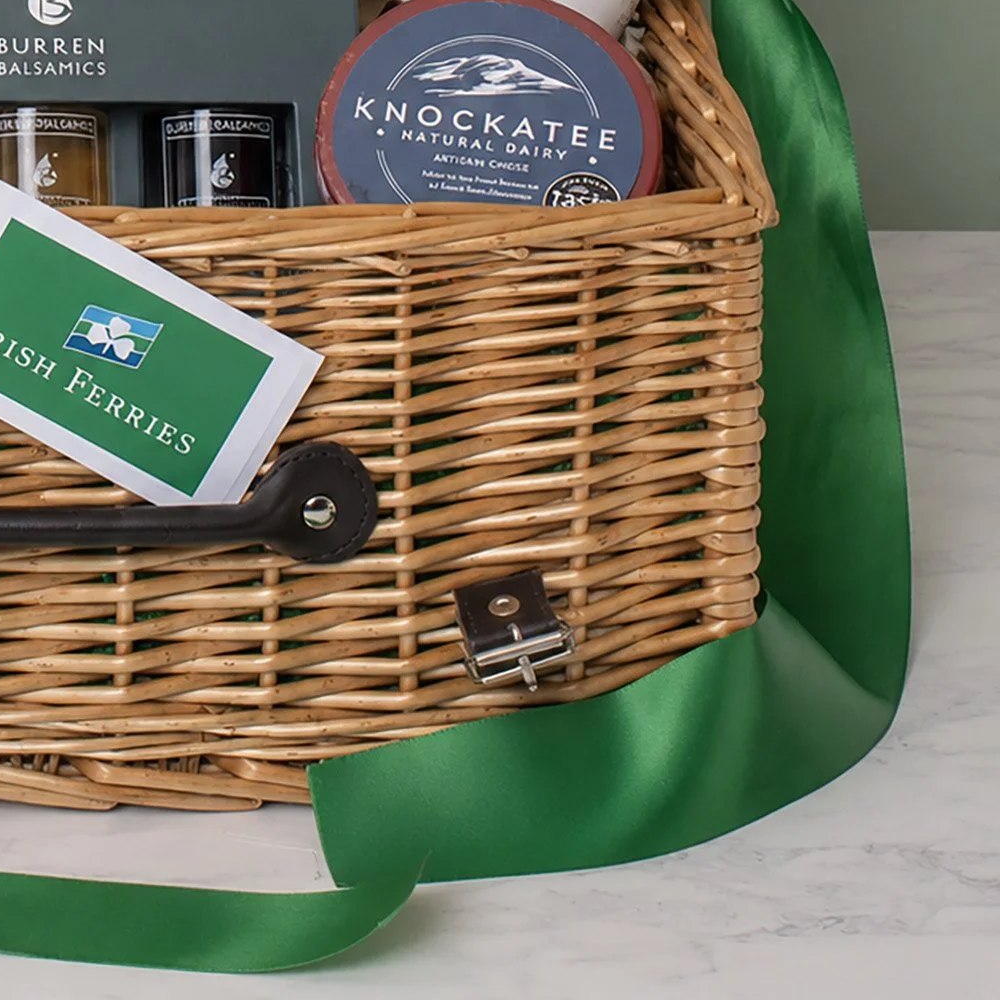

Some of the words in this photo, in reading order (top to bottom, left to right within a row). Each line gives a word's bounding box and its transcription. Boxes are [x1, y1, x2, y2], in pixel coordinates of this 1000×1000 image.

[354, 96, 617, 151] KNOCKATEE
[401, 130, 495, 152] NATURAL
[506, 143, 568, 161] DAIRY
